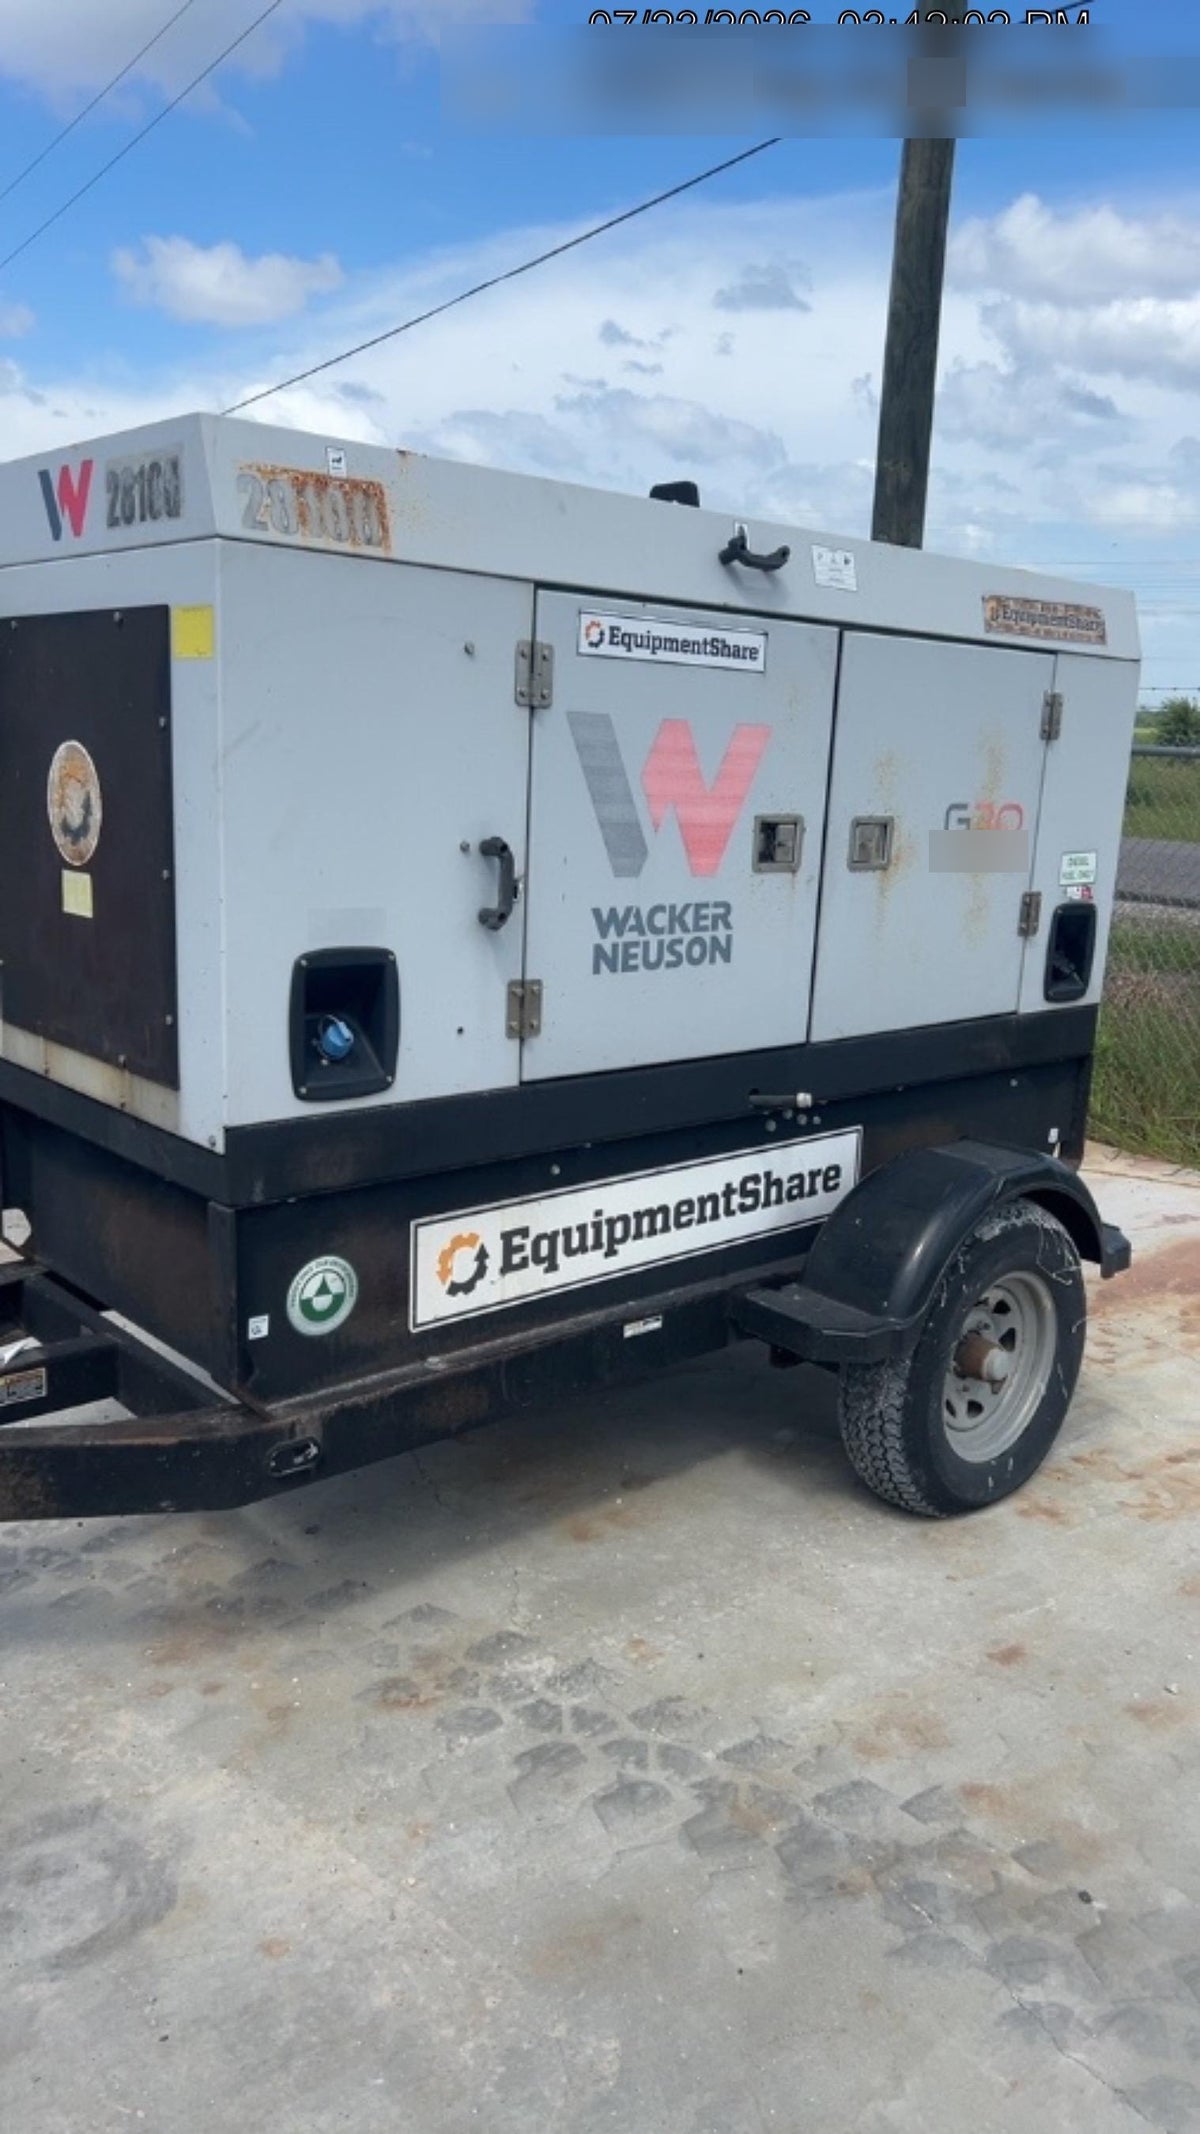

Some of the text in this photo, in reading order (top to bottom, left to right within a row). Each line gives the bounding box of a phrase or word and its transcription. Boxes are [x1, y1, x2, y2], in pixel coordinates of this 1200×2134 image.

[608, 625, 760, 661] EquipmentShare
[591, 900, 734, 939] WACKER
[592, 933, 733, 975] NEUSON
[500, 1162, 842, 1274] EquipmentShare
